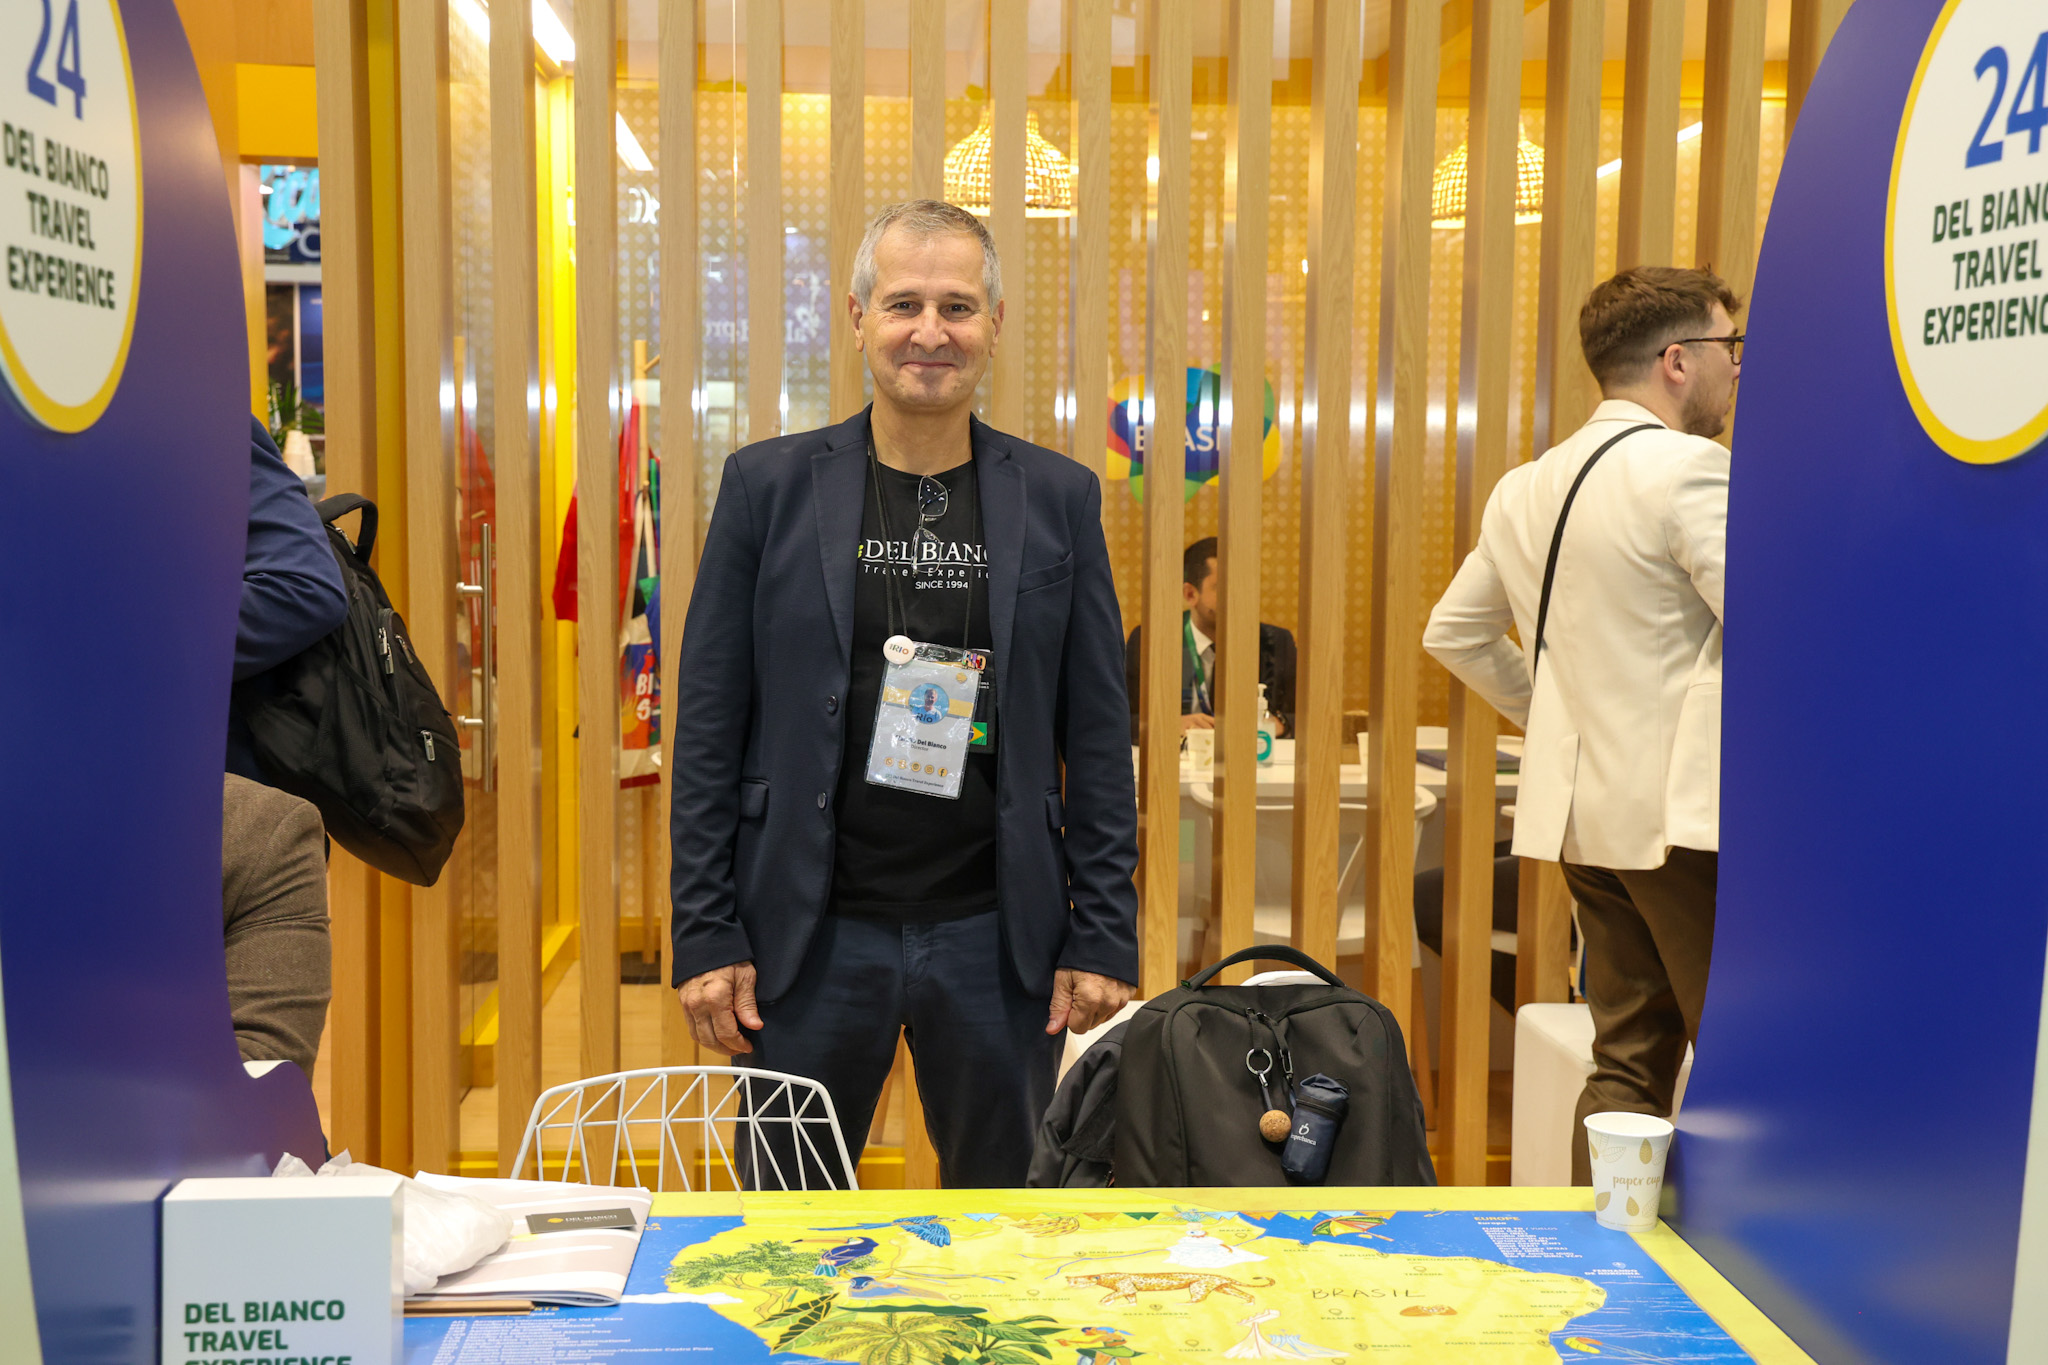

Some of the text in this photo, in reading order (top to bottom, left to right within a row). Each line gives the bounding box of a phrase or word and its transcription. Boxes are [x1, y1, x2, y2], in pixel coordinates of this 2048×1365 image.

[27, 0, 86, 120] 24
[1965, 30, 2048, 169] 24
[3, 121, 109, 201] DEL BIANCO
[26, 190, 95, 251] TRAVEL
[1932, 198, 1973, 244] DEL
[7, 245, 116, 310] EXPERIENCE
[1952, 239, 2043, 291] TRAVEL
[865, 538, 988, 563] DEL BIAN
[864, 564, 911, 577] Trave
[915, 580, 969, 590] SINCE 1994
[917, 739, 927, 747] Del
[928, 741, 947, 750] Bianco
[1613, 1175, 1661, 1191] paper cup
[1312, 1288, 1426, 1299] BRASIL
[185, 1299, 345, 1324] DEL BIANCO
[184, 1329, 289, 1353] TRAVEL
